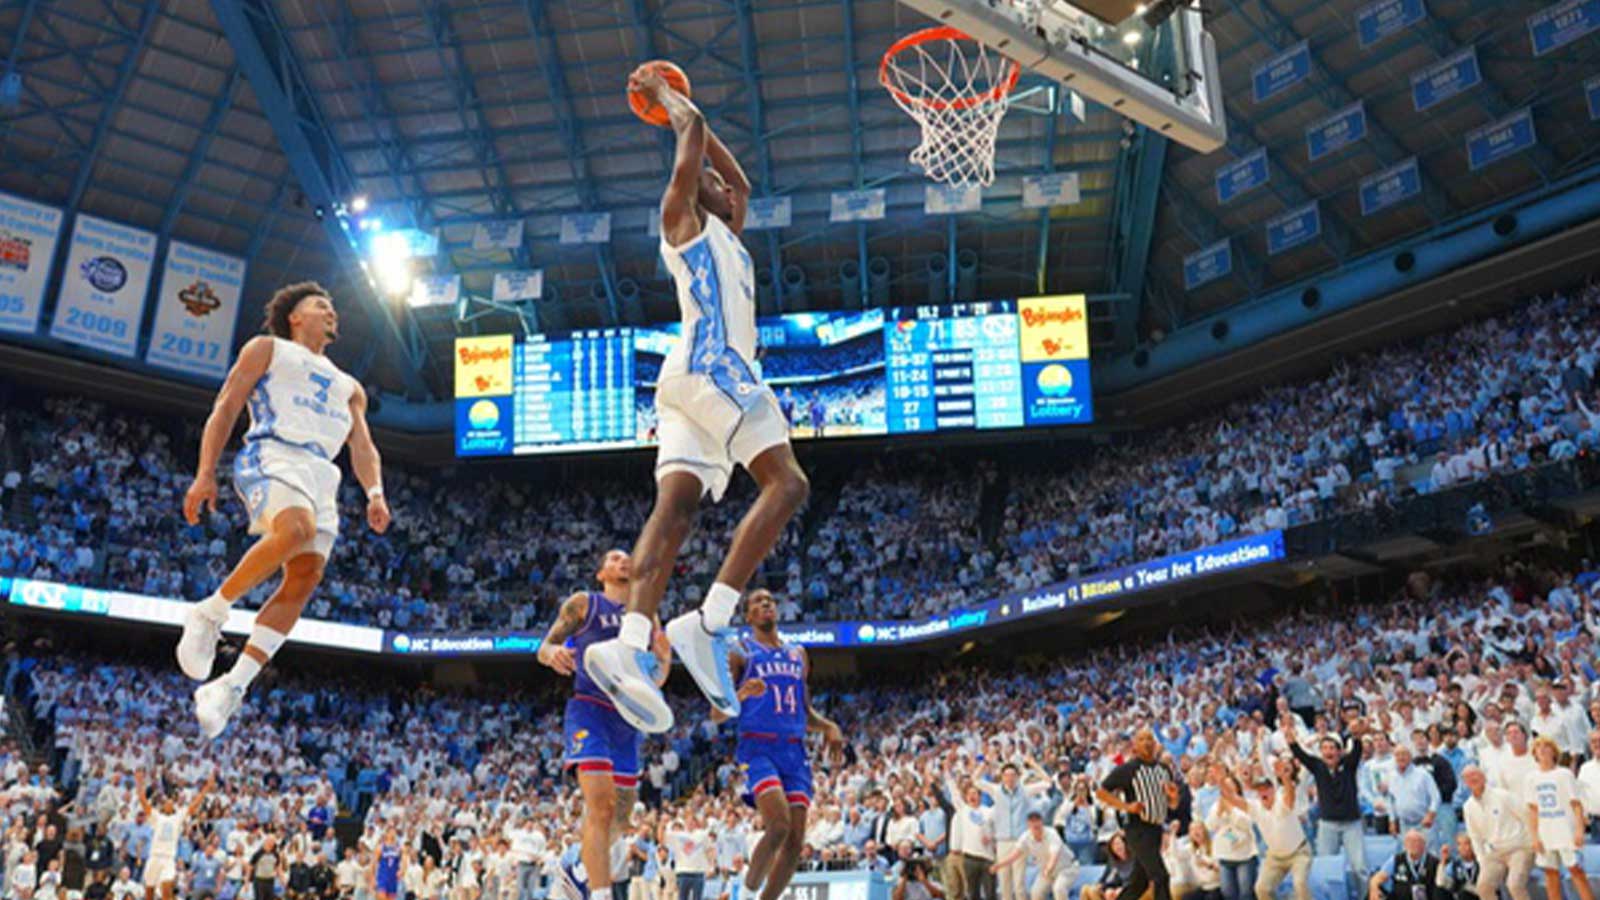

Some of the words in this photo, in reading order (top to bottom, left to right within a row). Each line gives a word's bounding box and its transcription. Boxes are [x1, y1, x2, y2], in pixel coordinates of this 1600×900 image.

[65, 306, 128, 338] 2009
[161, 332, 222, 361] 2017
[1136, 567, 1168, 587] Year
[1172, 560, 1193, 579] for
[1194, 543, 1270, 574] Education
[898, 618, 950, 640] Education
[949, 609, 988, 630] Lottery
[430, 635, 494, 652] Education
[494, 635, 541, 653] Lottery
[772, 684, 797, 715] 14
